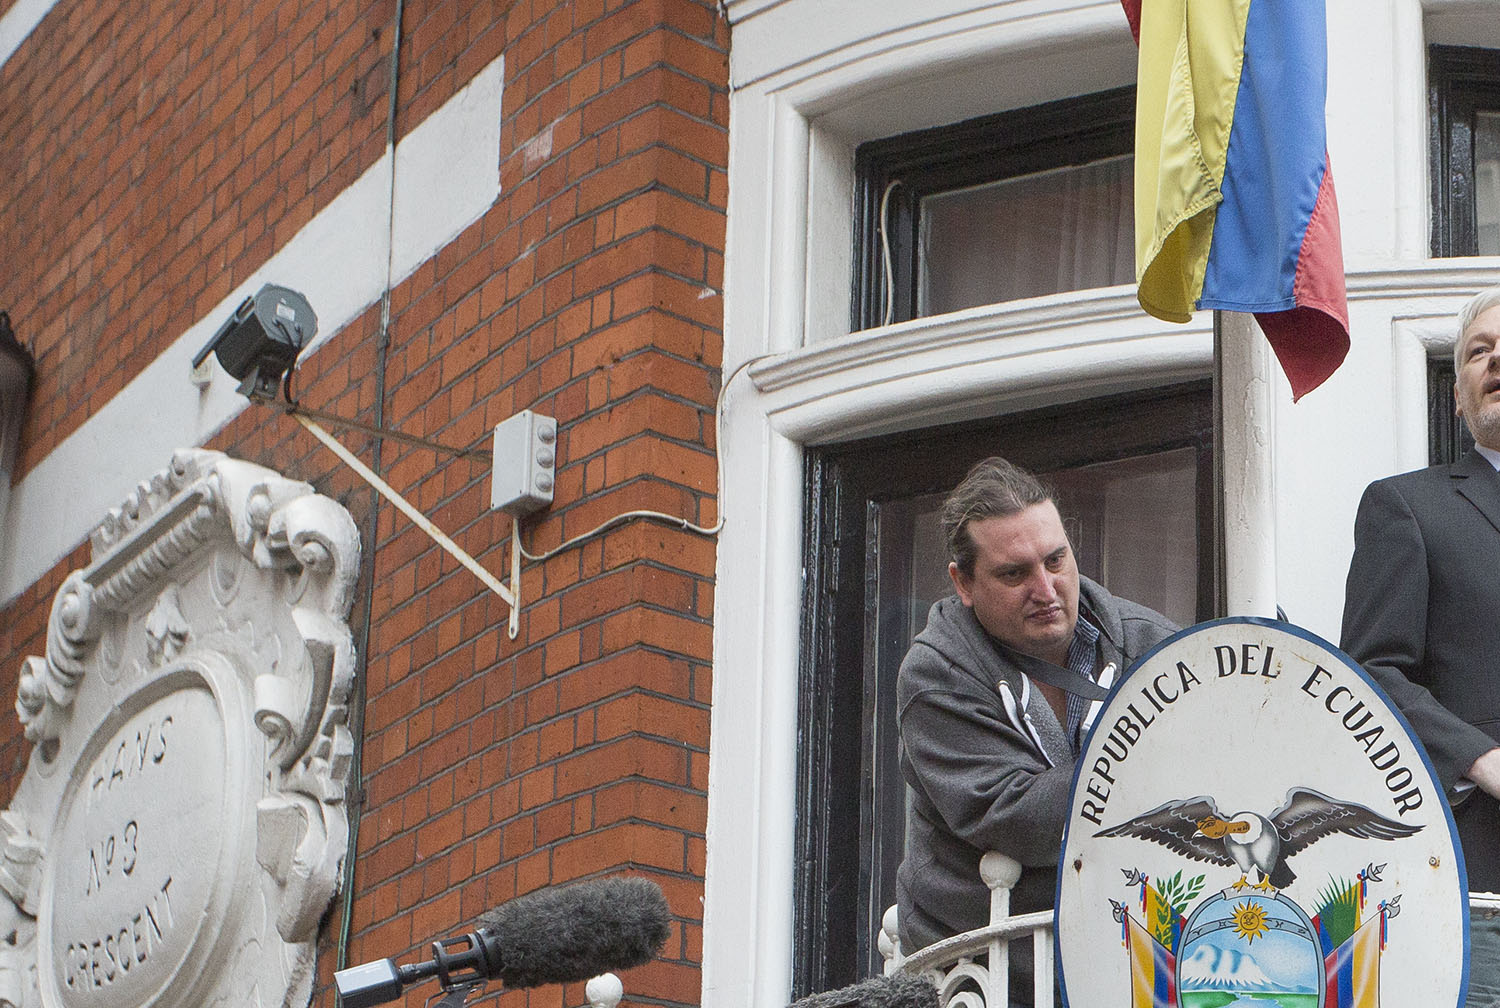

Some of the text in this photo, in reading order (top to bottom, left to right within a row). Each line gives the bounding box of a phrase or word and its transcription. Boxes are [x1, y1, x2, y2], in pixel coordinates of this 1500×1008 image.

[88, 716, 173, 803] HANS
[1081, 661, 1201, 825] REPUBLICA
[1214, 644, 1279, 678] DEL
[1301, 665, 1423, 817] ECUADOR
[65, 876, 174, 991] CRESCENT
